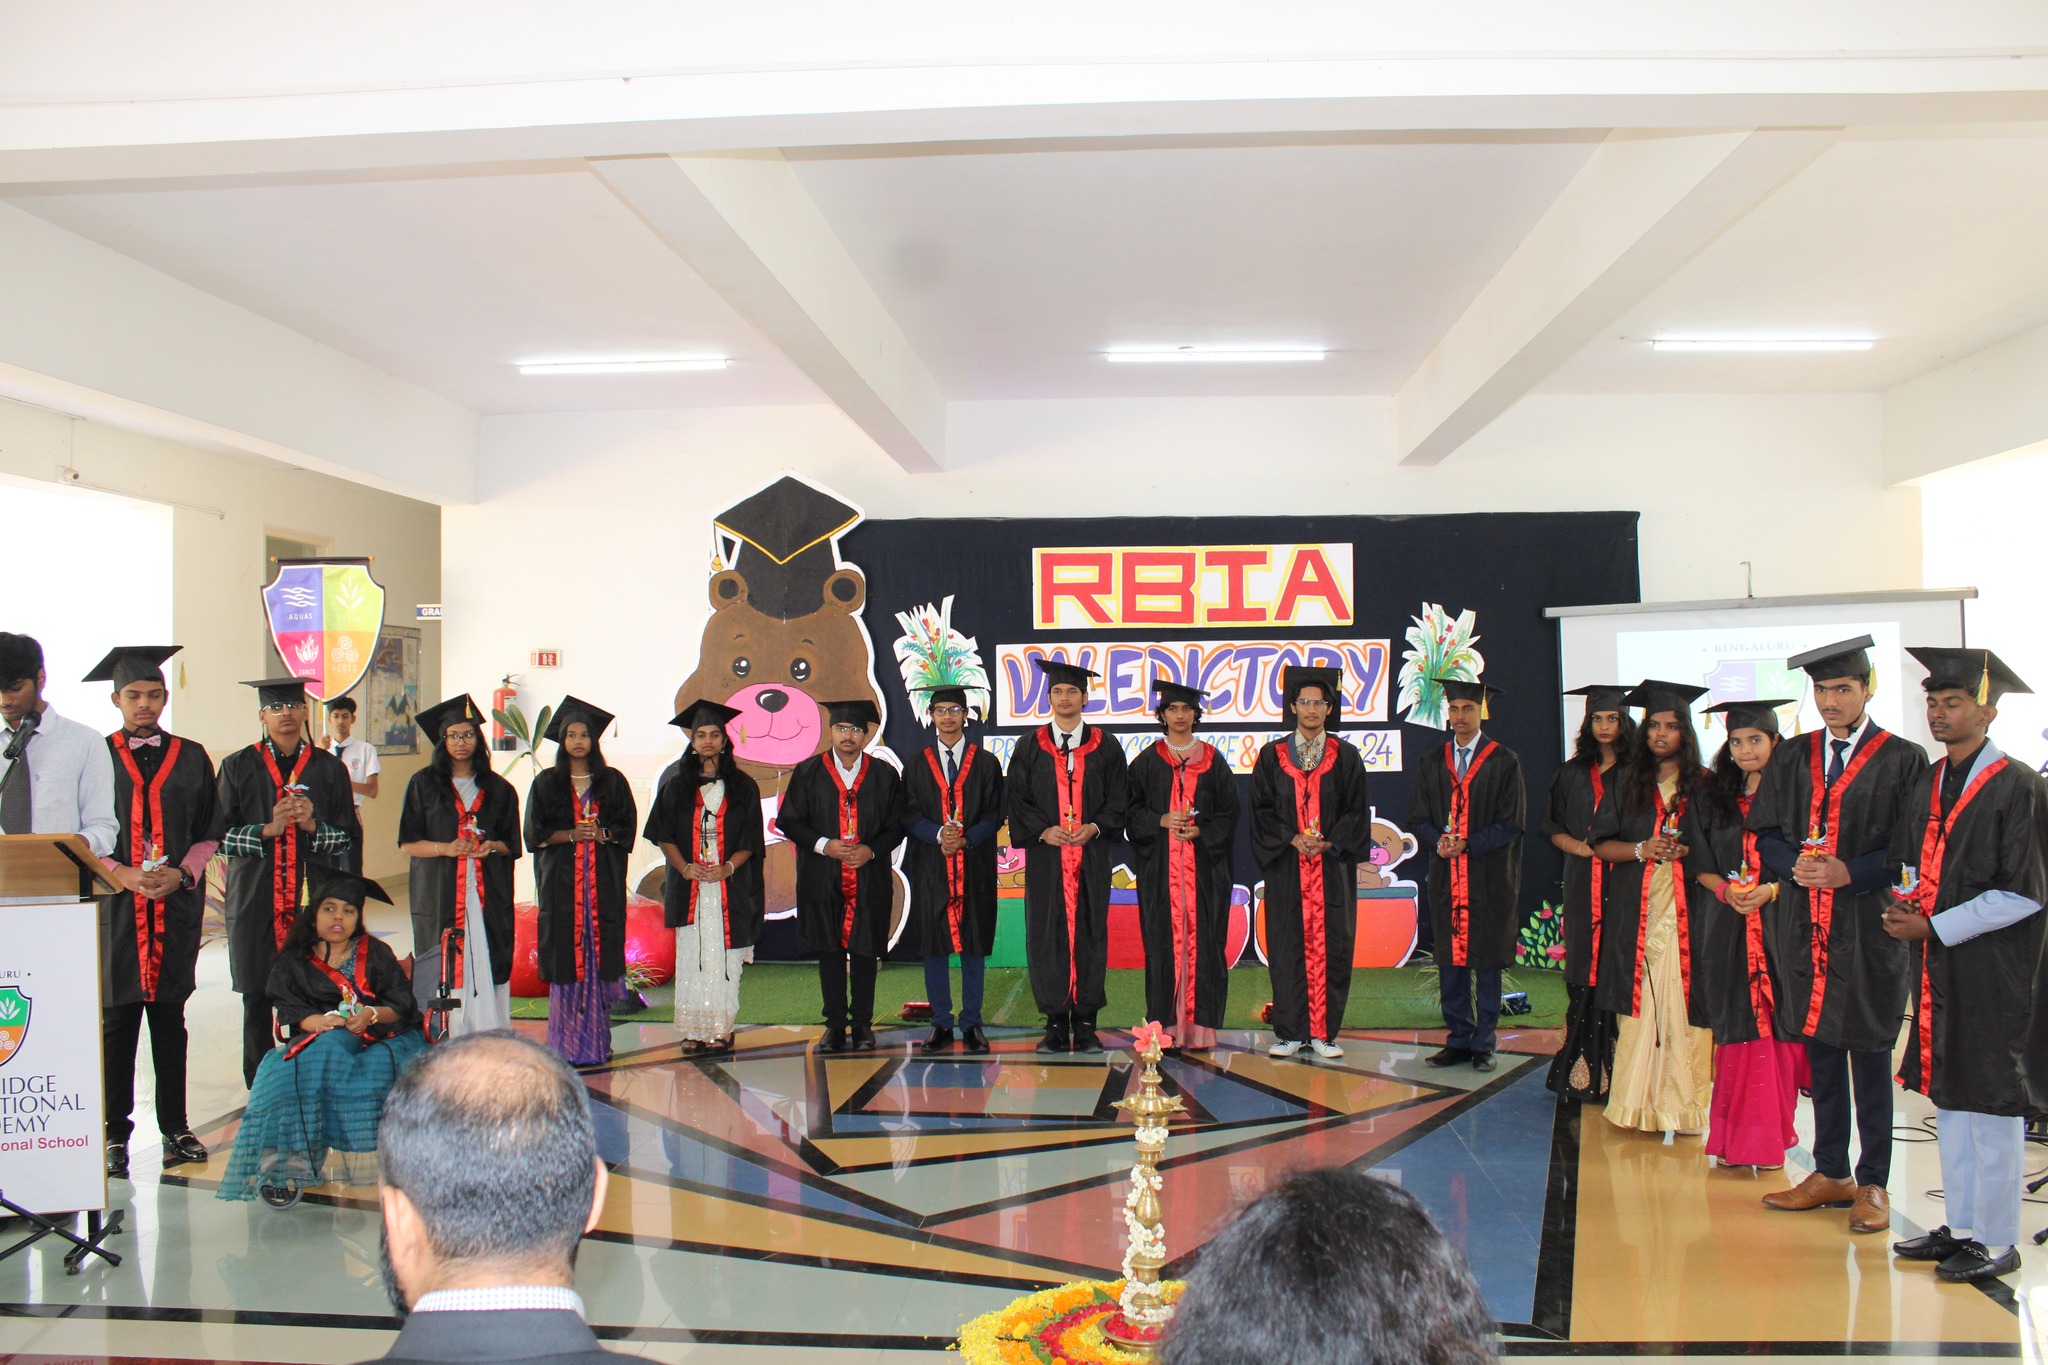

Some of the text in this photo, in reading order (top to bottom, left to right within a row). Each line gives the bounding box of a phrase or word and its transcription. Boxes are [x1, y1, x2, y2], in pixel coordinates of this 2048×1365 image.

[1038, 547, 1352, 626] RBIA
[288, 612, 313, 620] AQUAS
[421, 607, 442, 616] GRA
[1714, 641, 1796, 653] BENGALURU
[1, 1074, 57, 1095] IDGE
[0, 1093, 86, 1114] TIONAL
[0, 1114, 50, 1135] EMY
[0, 1134, 89, 1152] onal School
